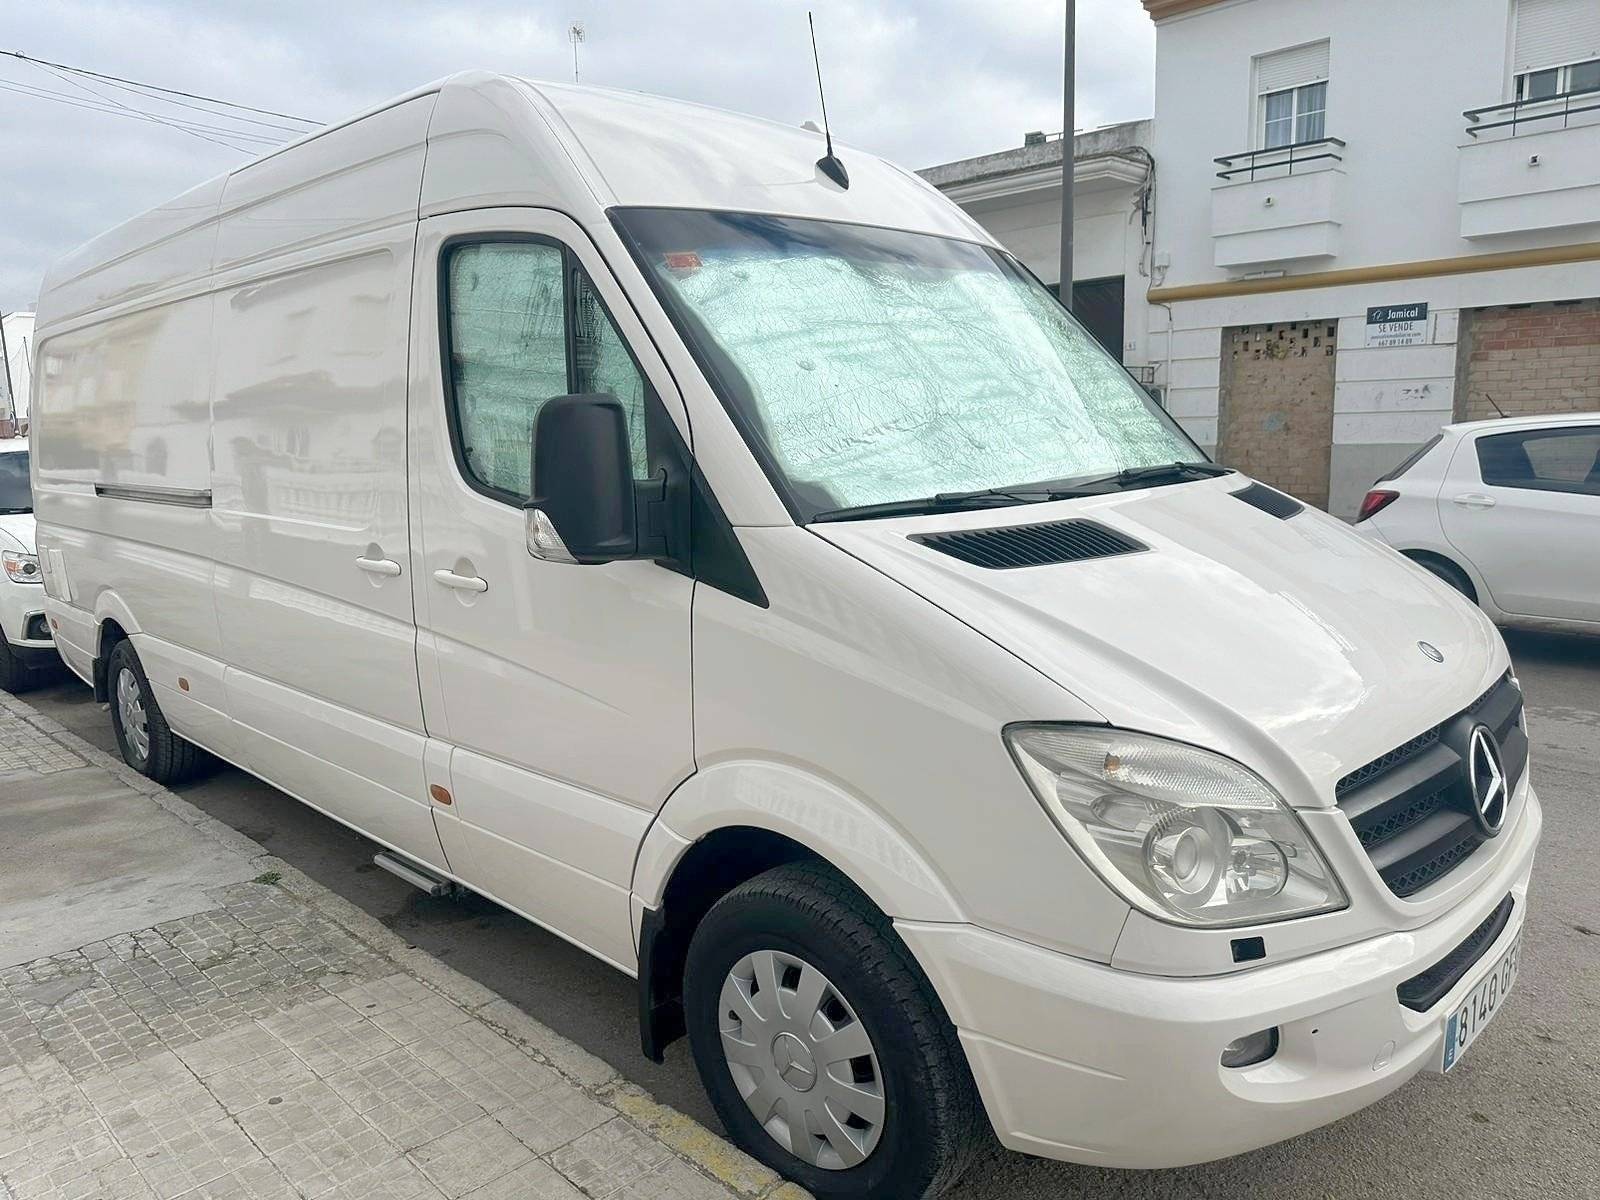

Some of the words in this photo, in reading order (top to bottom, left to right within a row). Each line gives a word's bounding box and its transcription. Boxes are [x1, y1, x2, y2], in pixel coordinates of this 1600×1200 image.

[1387, 307, 1418, 320] Jamical
[1378, 323, 1387, 334] SE
[1389, 321, 1414, 332] VENDE
[1458, 973, 1498, 1047] 8140
